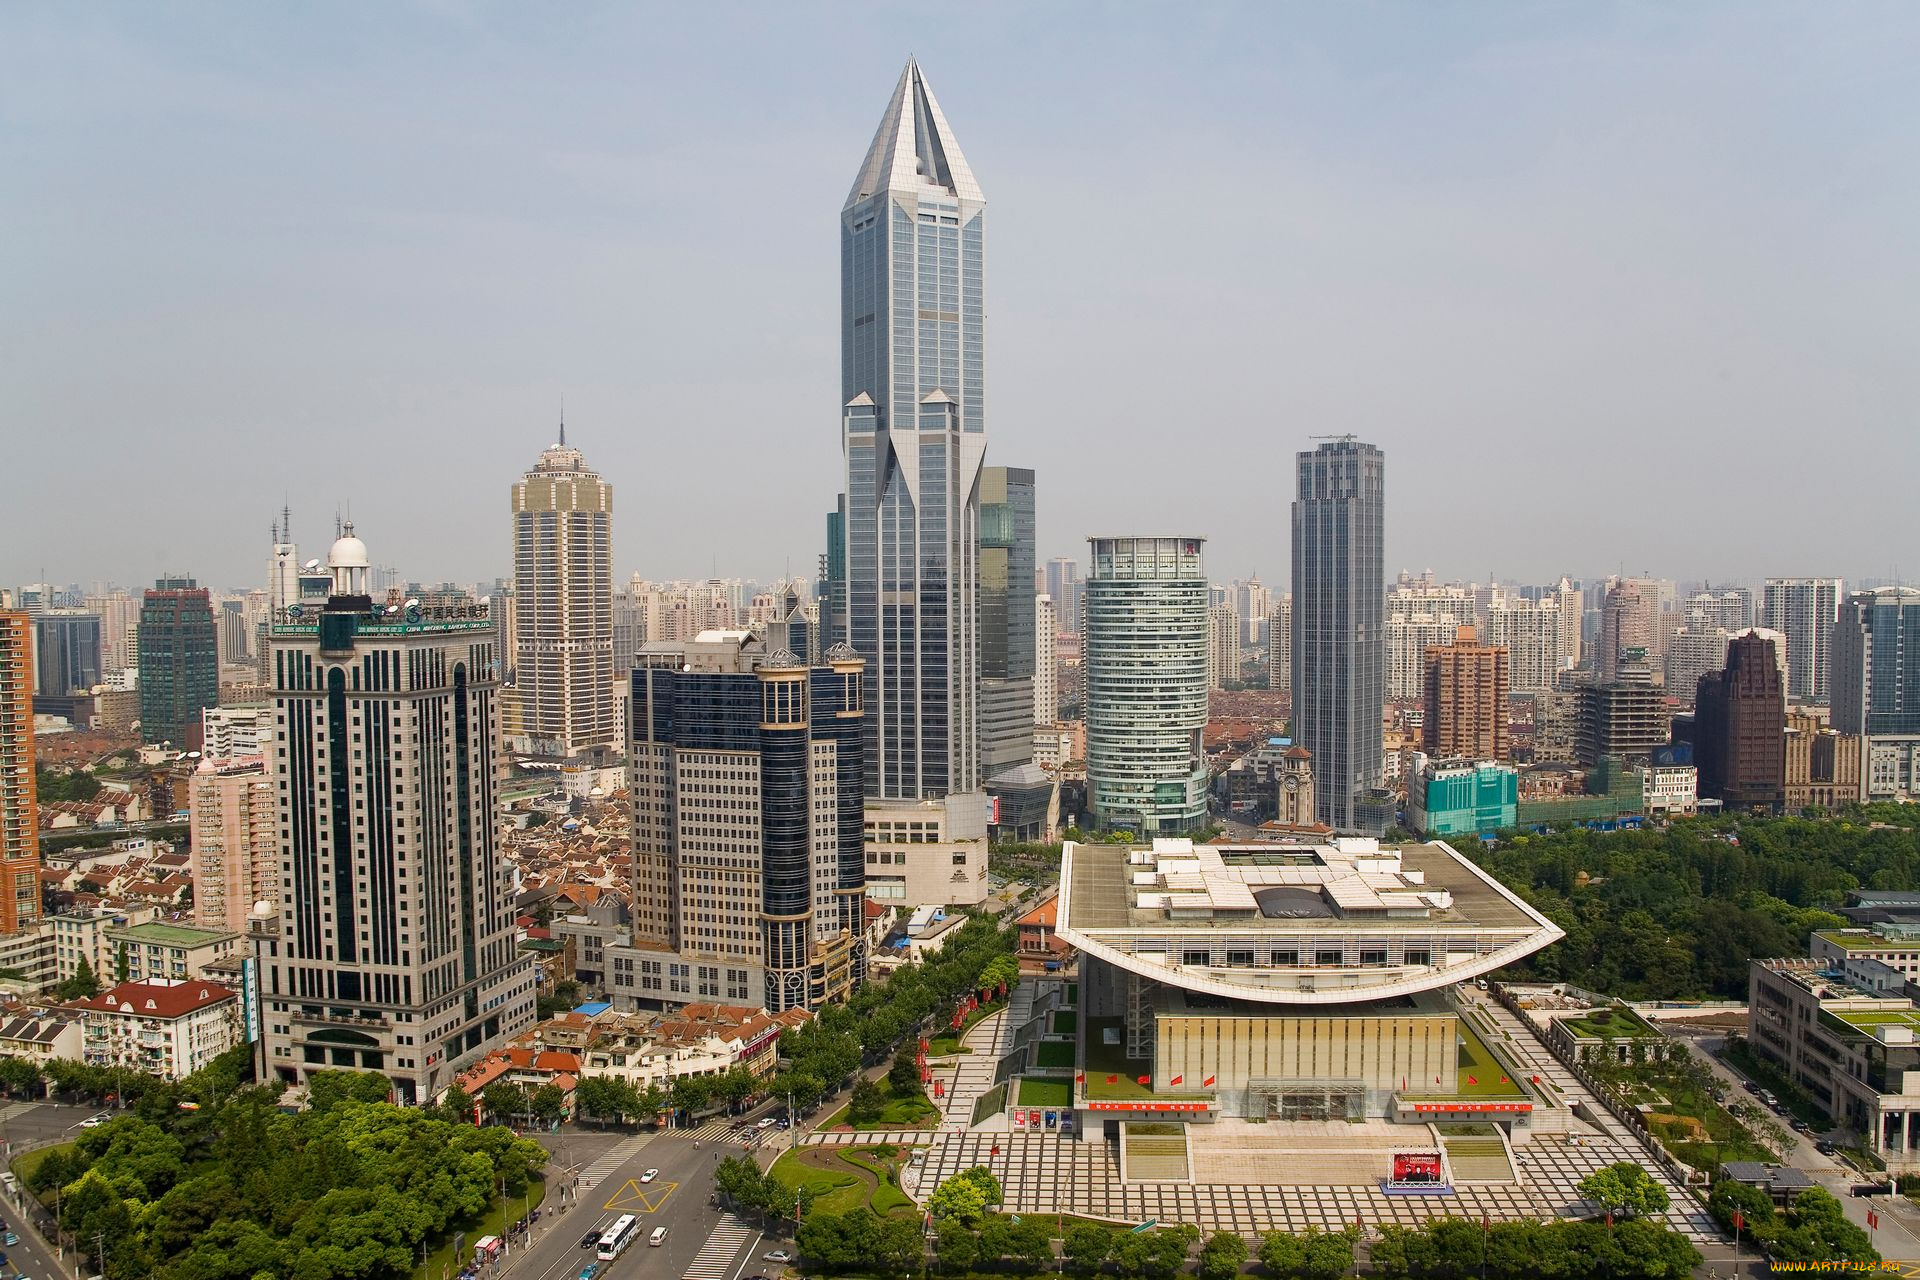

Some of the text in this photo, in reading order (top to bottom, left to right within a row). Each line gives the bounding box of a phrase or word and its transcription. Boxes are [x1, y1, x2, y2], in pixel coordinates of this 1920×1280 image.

[422, 605, 489, 620] 中国民生银行
